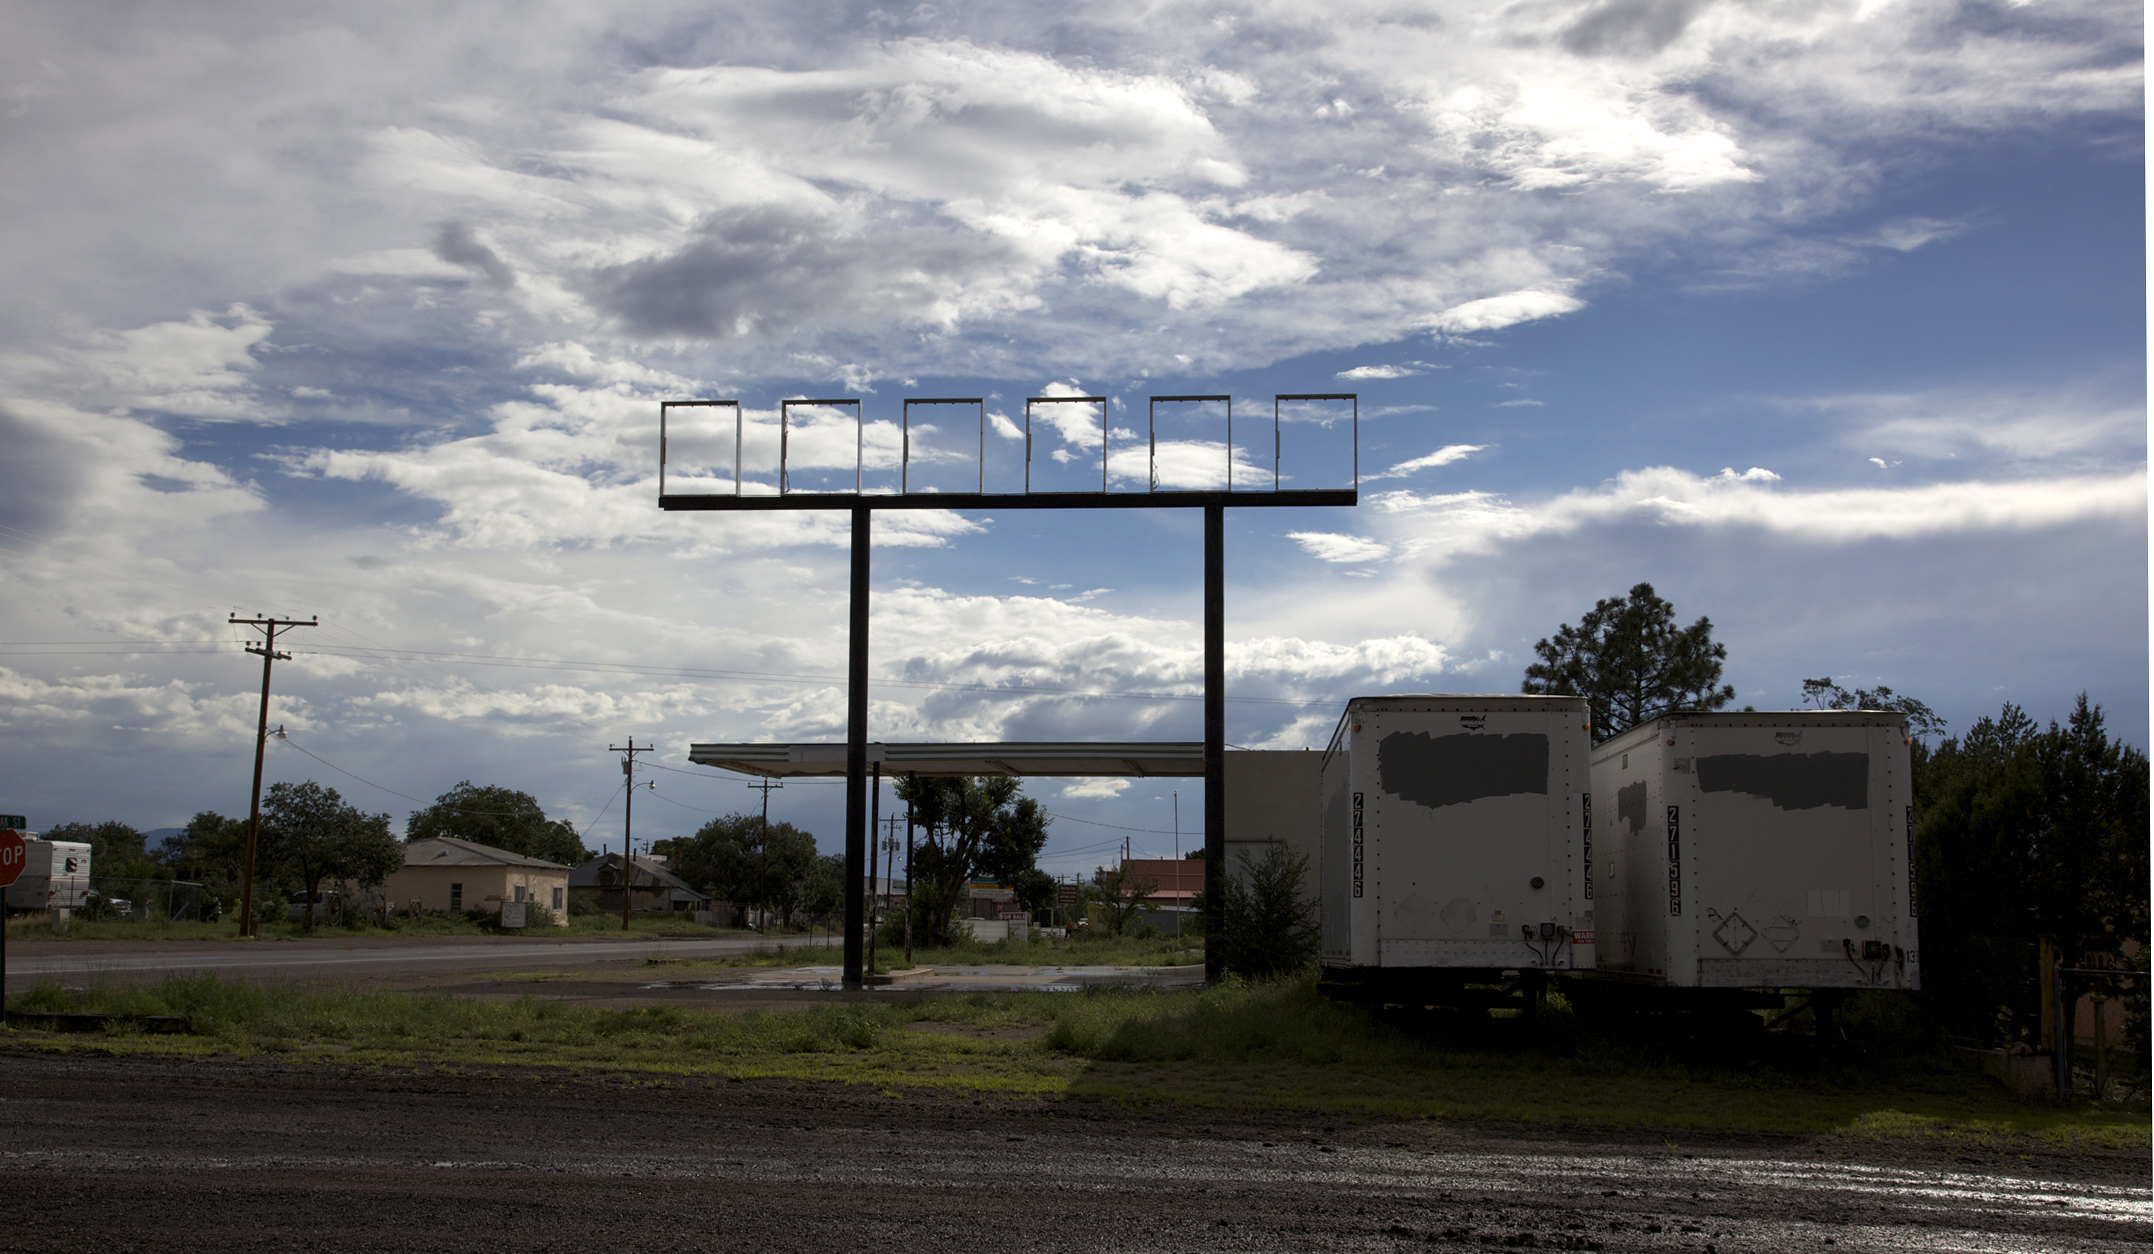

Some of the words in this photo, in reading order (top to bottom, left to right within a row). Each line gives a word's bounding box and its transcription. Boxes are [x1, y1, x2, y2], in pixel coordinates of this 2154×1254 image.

[0, 845, 24, 866] OP
[13, 817, 21, 828] ST
[1354, 793, 1363, 897] 274446
[1583, 793, 1593, 899] 274446
[1669, 807, 1680, 914] 271596
